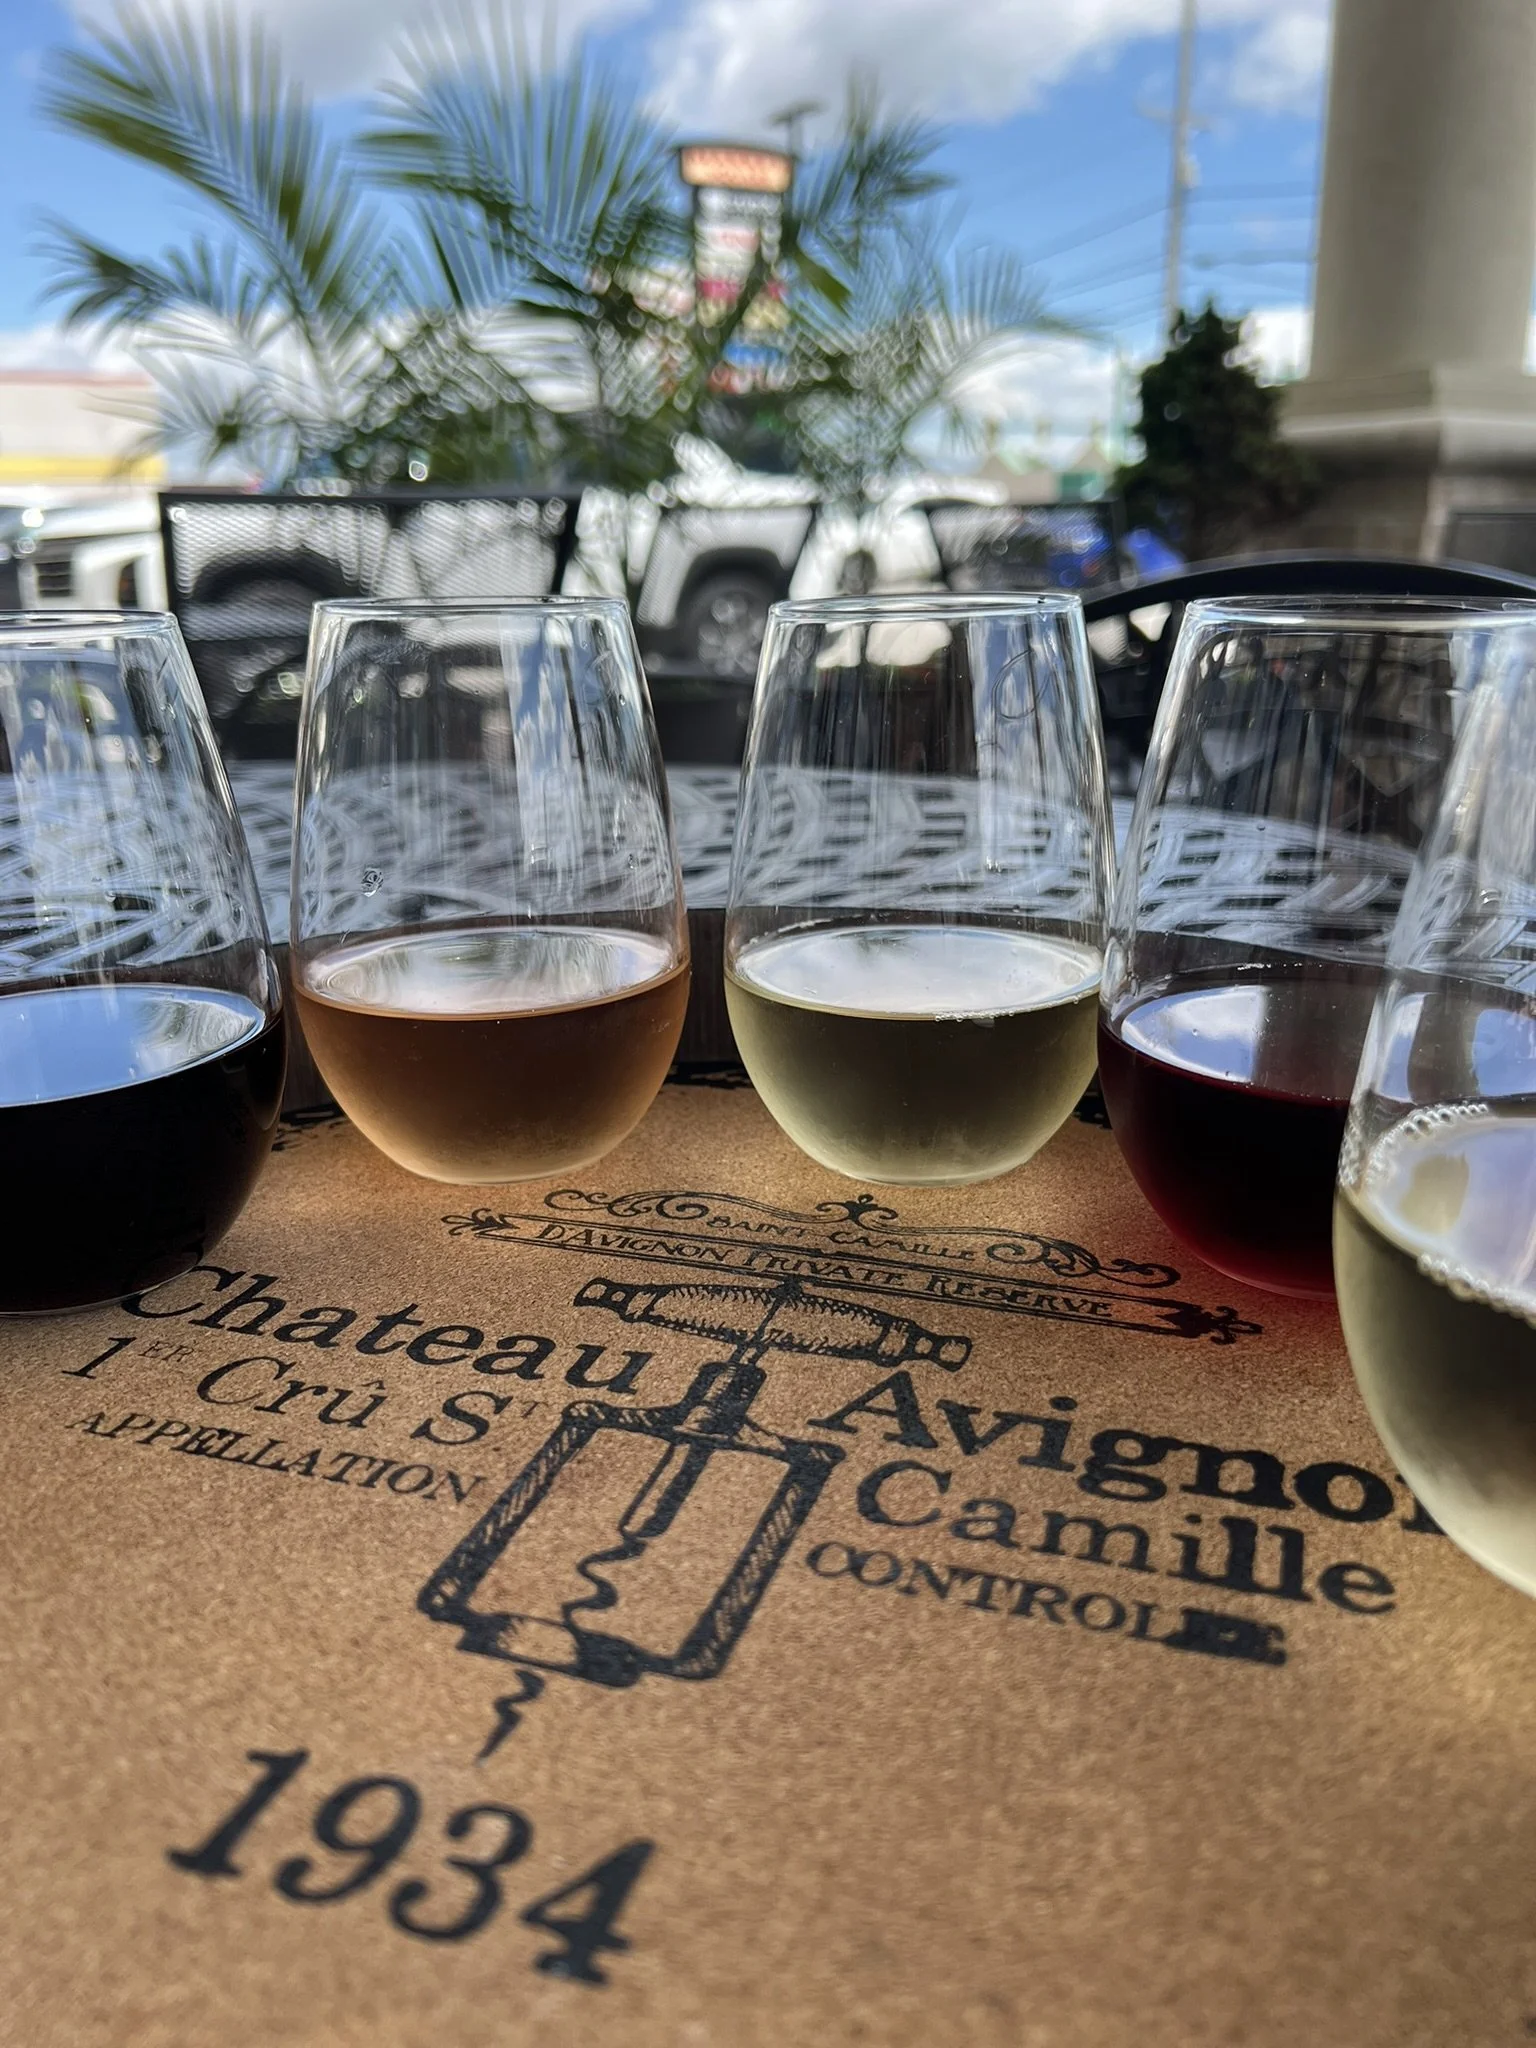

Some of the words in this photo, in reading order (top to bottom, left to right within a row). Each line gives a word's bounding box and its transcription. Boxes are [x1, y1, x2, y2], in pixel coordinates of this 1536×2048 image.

[707, 1214, 812, 1239] SAINT
[829, 1231, 977, 1262] CAMILLE
[744, 1249, 907, 1288] PRIVATE
[924, 1274, 1114, 1318] RESERVE
[121, 1265, 654, 1396] Chateau
[196, 1356, 388, 1429] Crû
[64, 1411, 487, 1503] APPELLATION
[856, 1459, 1398, 1615] Camille
[165, 1746, 656, 1989] 1934
